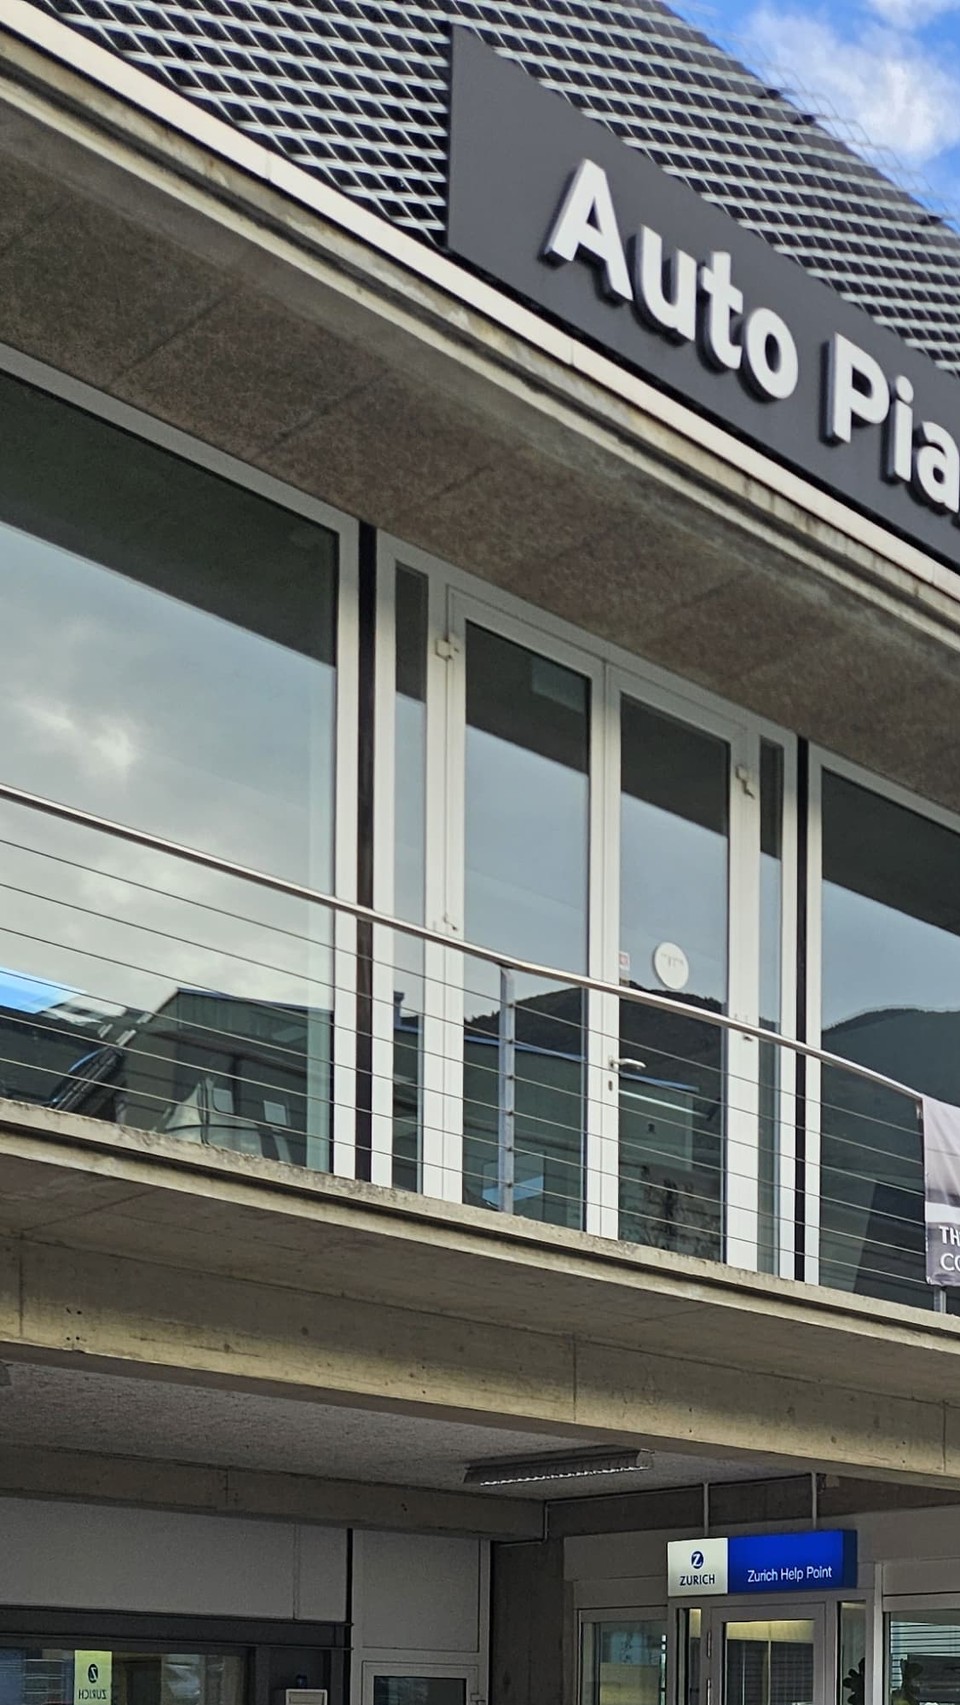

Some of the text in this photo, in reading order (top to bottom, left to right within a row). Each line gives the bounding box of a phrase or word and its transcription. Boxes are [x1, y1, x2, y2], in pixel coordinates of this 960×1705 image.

[543, 159, 799, 404] Auto
[679, 1574, 716, 1586] ZURICH
[747, 1566, 832, 1583] Zurich Help Point
